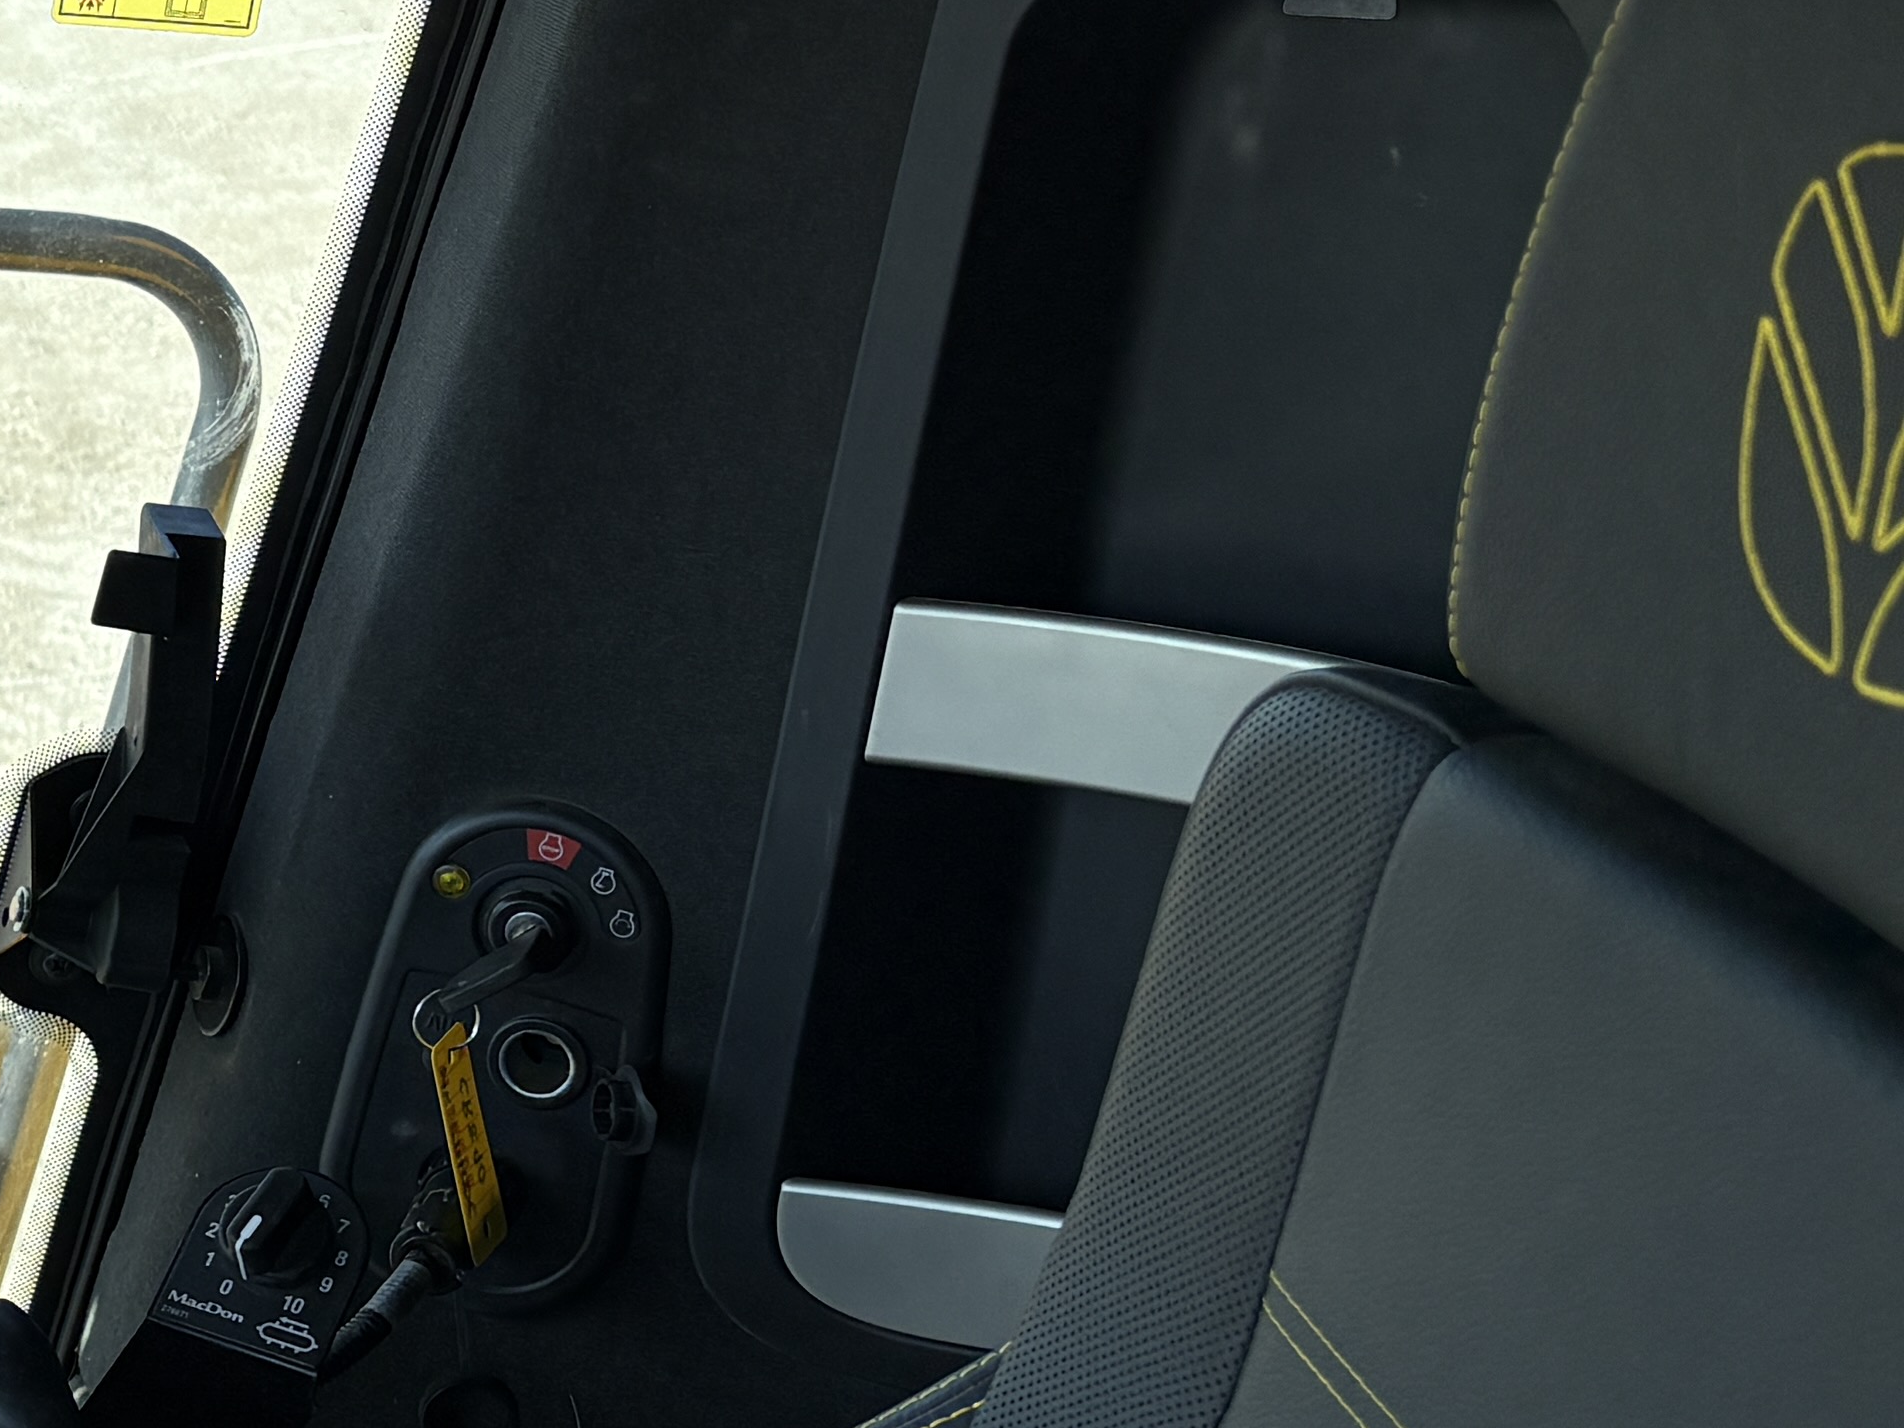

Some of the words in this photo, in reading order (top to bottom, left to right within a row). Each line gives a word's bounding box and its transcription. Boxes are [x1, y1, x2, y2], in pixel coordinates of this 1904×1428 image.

[205, 1222, 220, 1239] 2
[337, 1218, 351, 1234] 7
[204, 1252, 216, 1267] 1
[334, 1250, 349, 1267] 8
[219, 1278, 234, 1295] 0
[318, 1277, 334, 1293] 9
[168, 1289, 244, 1323] MacDon
[283, 1295, 305, 1315] 10
